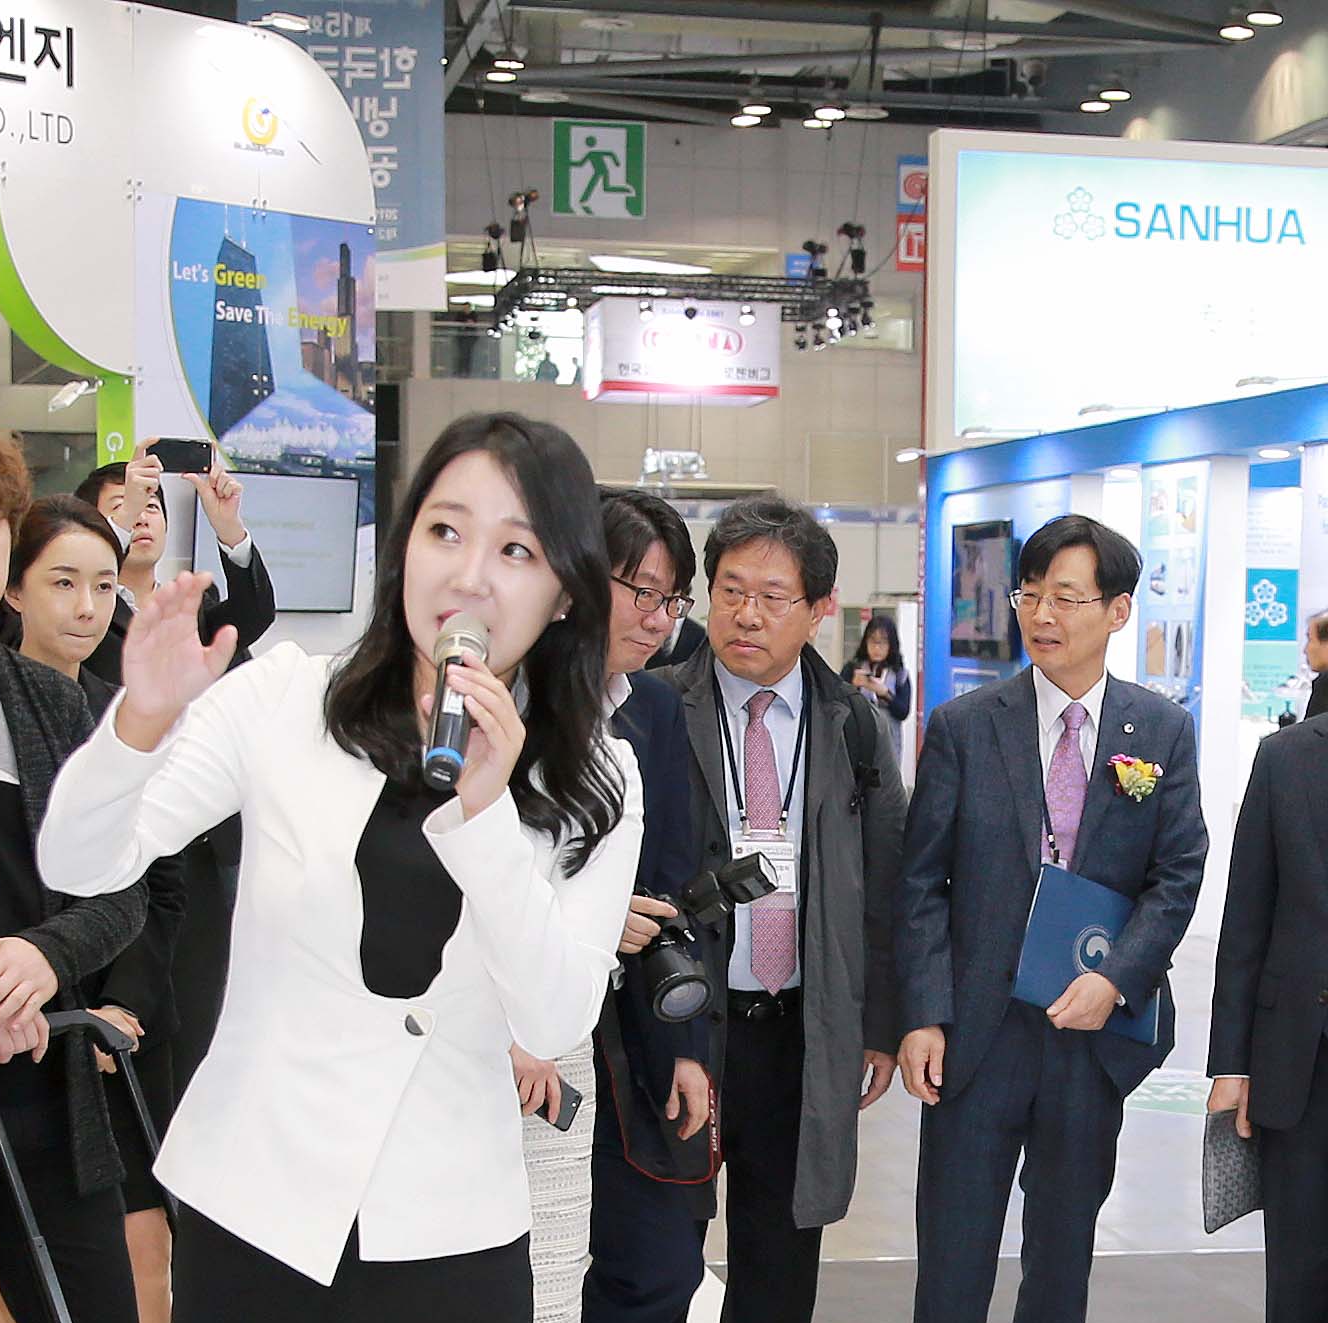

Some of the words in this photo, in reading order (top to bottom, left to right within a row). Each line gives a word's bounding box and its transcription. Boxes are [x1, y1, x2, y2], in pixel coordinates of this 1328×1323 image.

[1114, 202, 1306, 245] SANHUA
[173, 261, 209, 283] Let's
[213, 263, 268, 290] Green
[215, 300, 253, 324] Save
[287, 307, 348, 337] Energy
